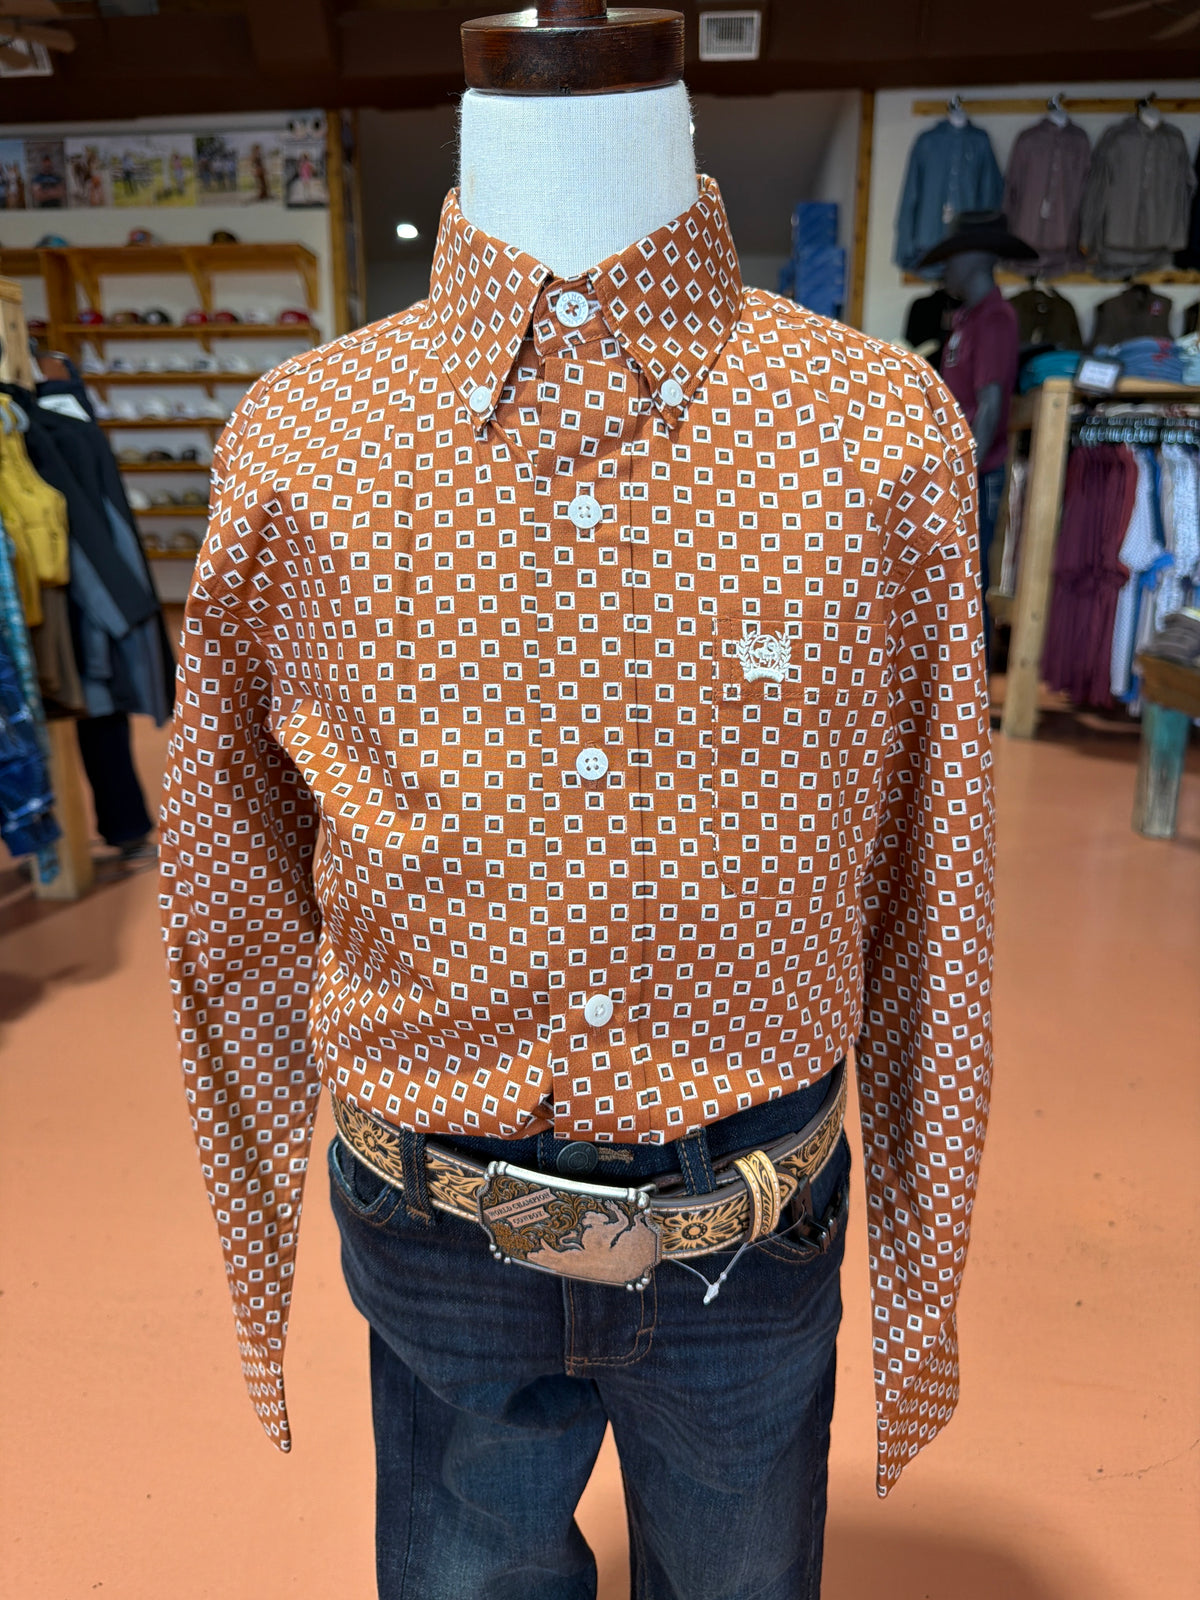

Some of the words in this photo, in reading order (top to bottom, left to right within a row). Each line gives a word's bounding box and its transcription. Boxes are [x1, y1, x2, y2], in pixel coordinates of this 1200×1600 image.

[562, 293, 587, 308] CINCH
[488, 1205, 512, 1217] WORLD
[512, 1191, 551, 1210] CHAMPION
[512, 1210, 544, 1224] COWBOY
